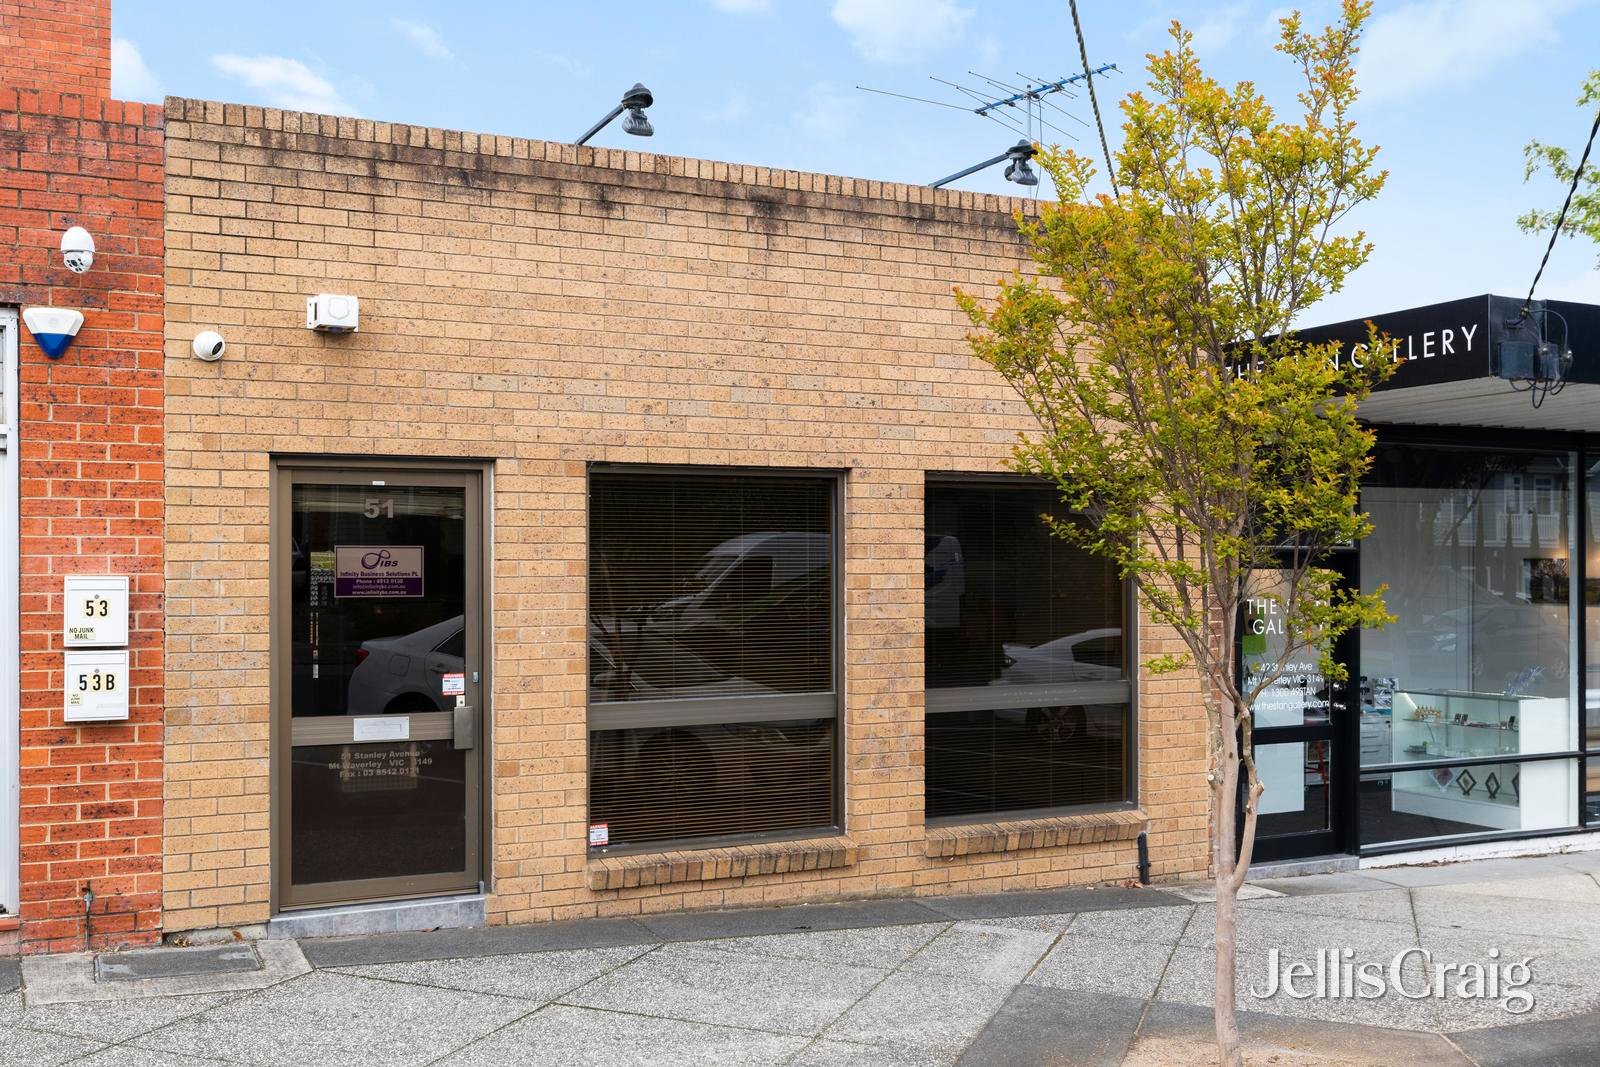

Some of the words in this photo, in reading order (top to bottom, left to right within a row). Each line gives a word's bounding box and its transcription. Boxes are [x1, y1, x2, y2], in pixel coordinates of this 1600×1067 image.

[1351, 324, 1478, 369] GLLERY
[363, 498, 394, 519] 51
[86, 600, 108, 617] 53
[1247, 598, 1277, 614] THE
[1298, 662, 1313, 671] Ave
[79, 674, 115, 691] 53B
[1292, 674, 1305, 684] VIC
[1271, 688, 1289, 697] 1300
[353, 751, 387, 760] Stanley
[342, 760, 382, 769] Waverley
[339, 770, 356, 778] Fax
[363, 769, 374, 777] 03
